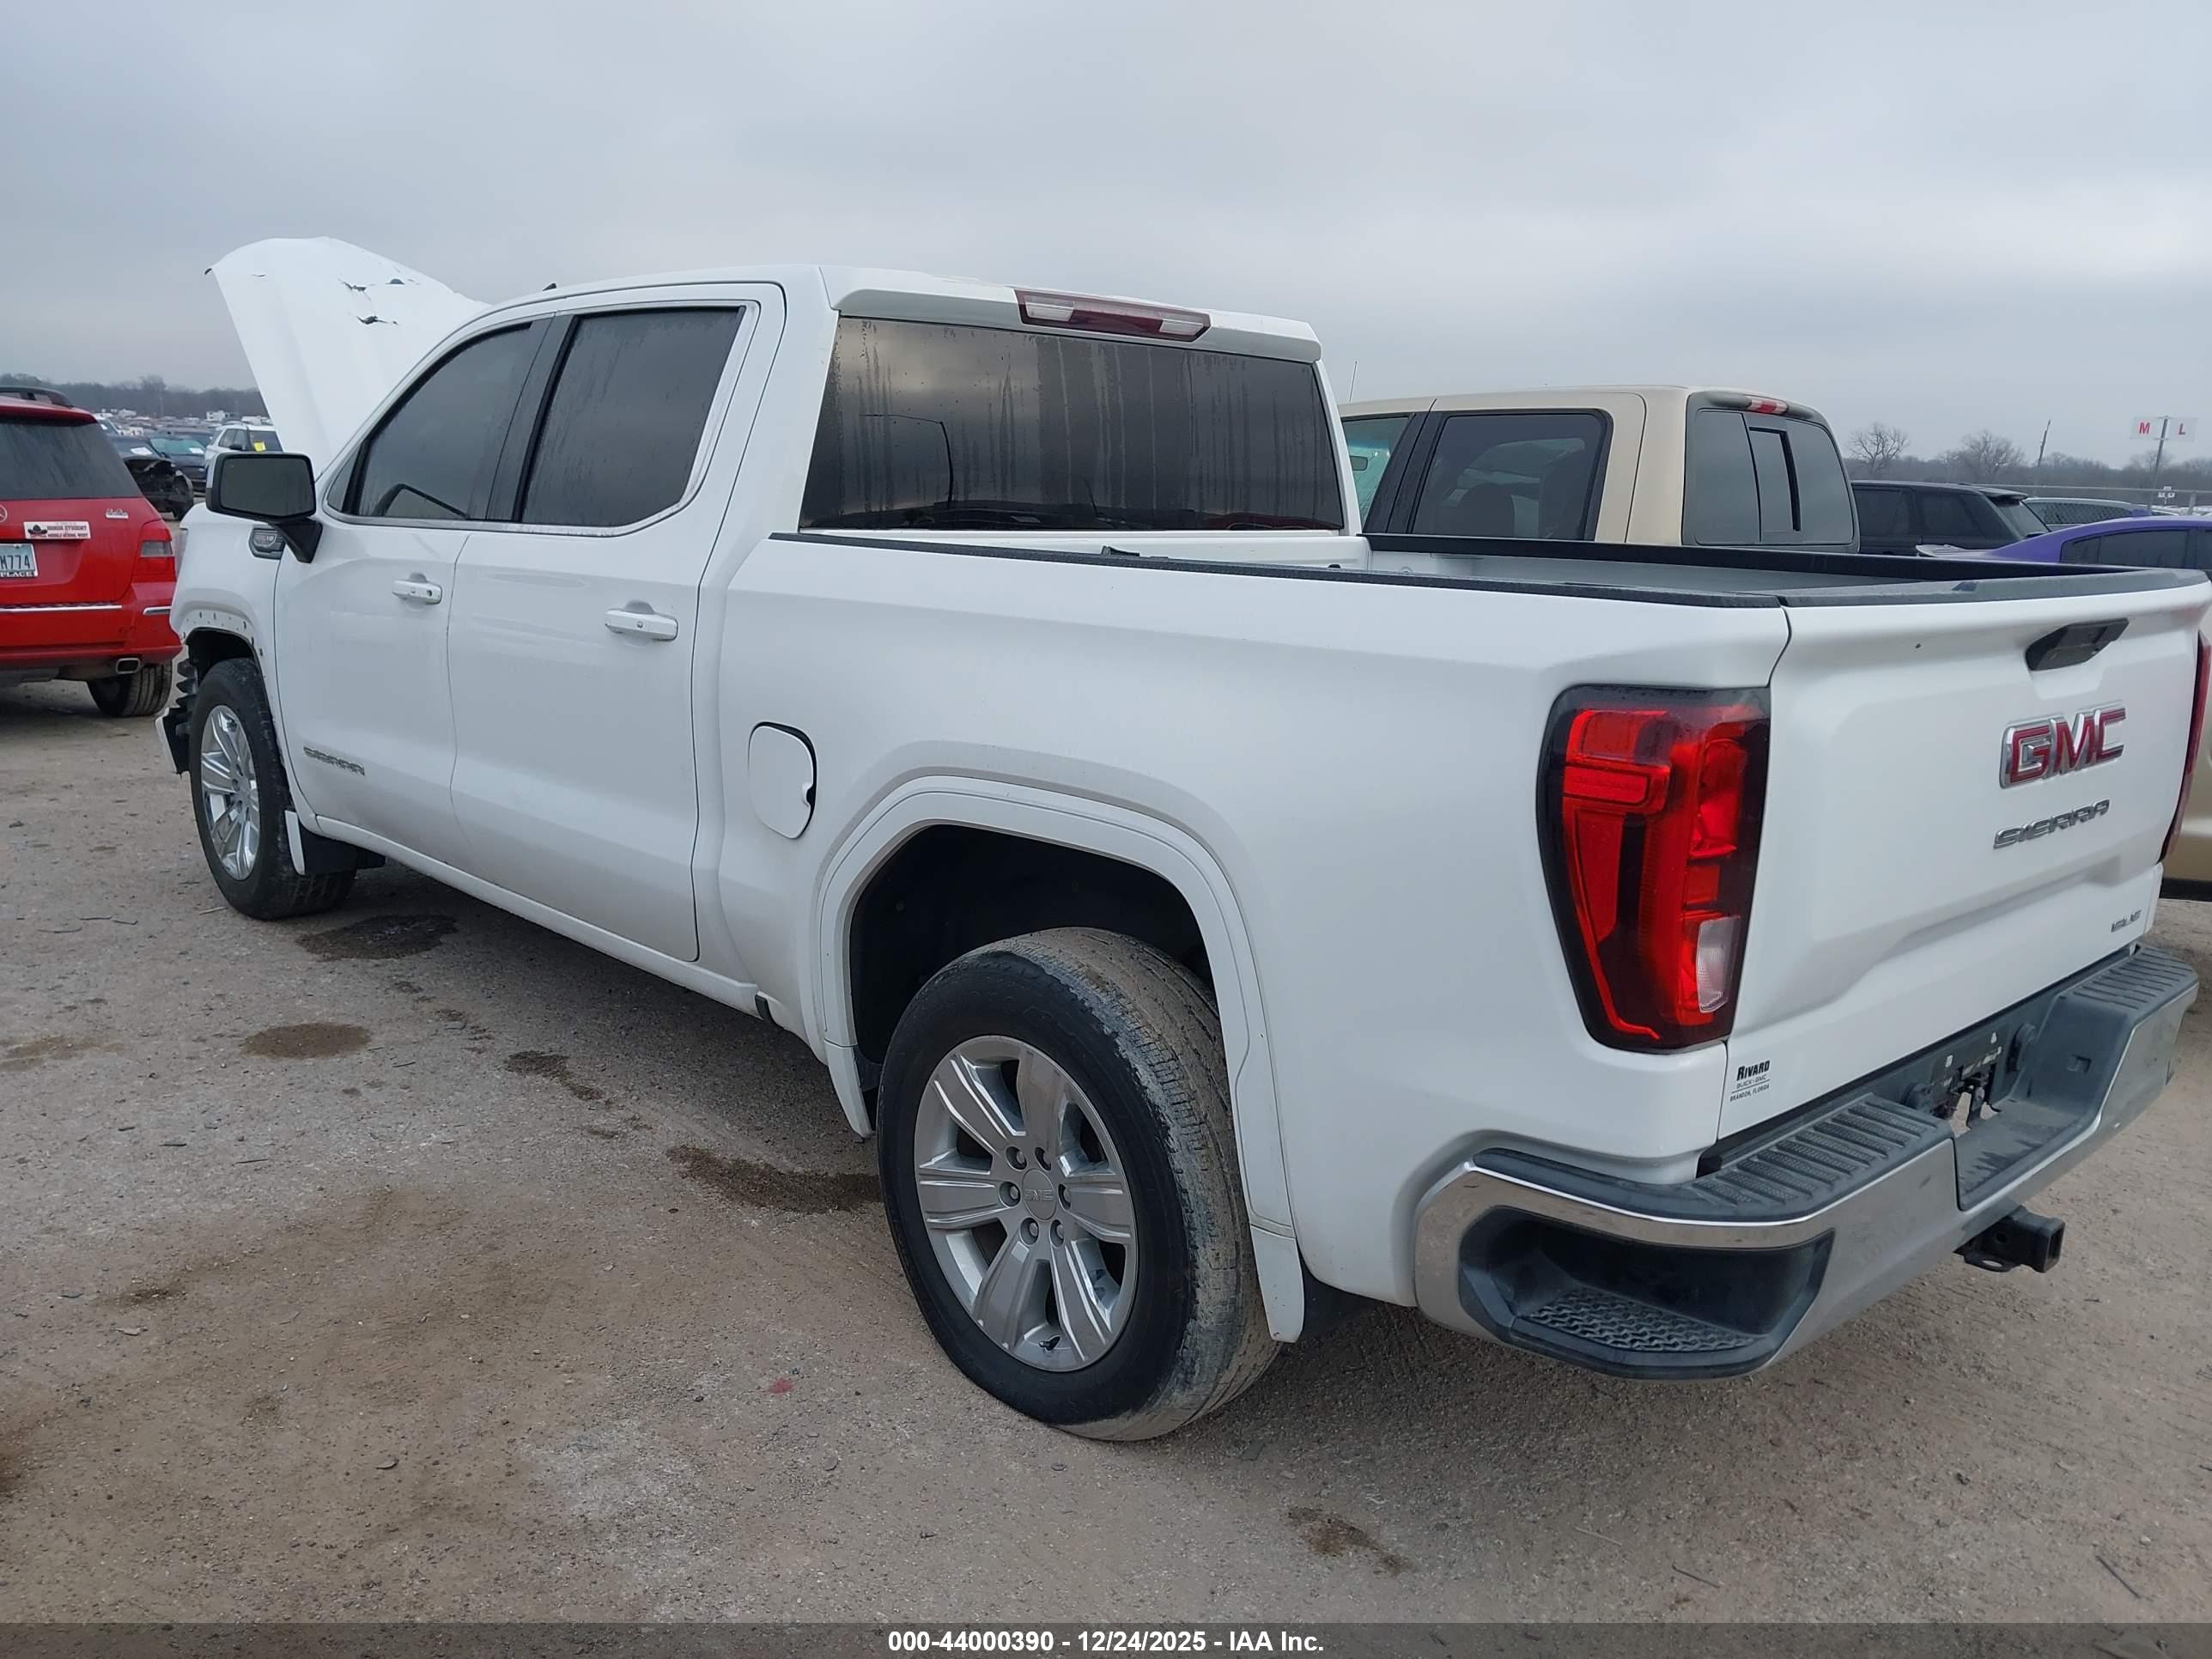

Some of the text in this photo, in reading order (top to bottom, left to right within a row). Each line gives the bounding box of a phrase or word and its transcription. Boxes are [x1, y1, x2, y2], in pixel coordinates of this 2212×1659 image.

[2139, 422, 2150, 434] M
[2179, 423, 2185, 434] L
[2000, 704, 2126, 788] GMC
[1993, 799, 2110, 849] SIERRA
[1736, 1060, 1770, 1082] RIVARD
